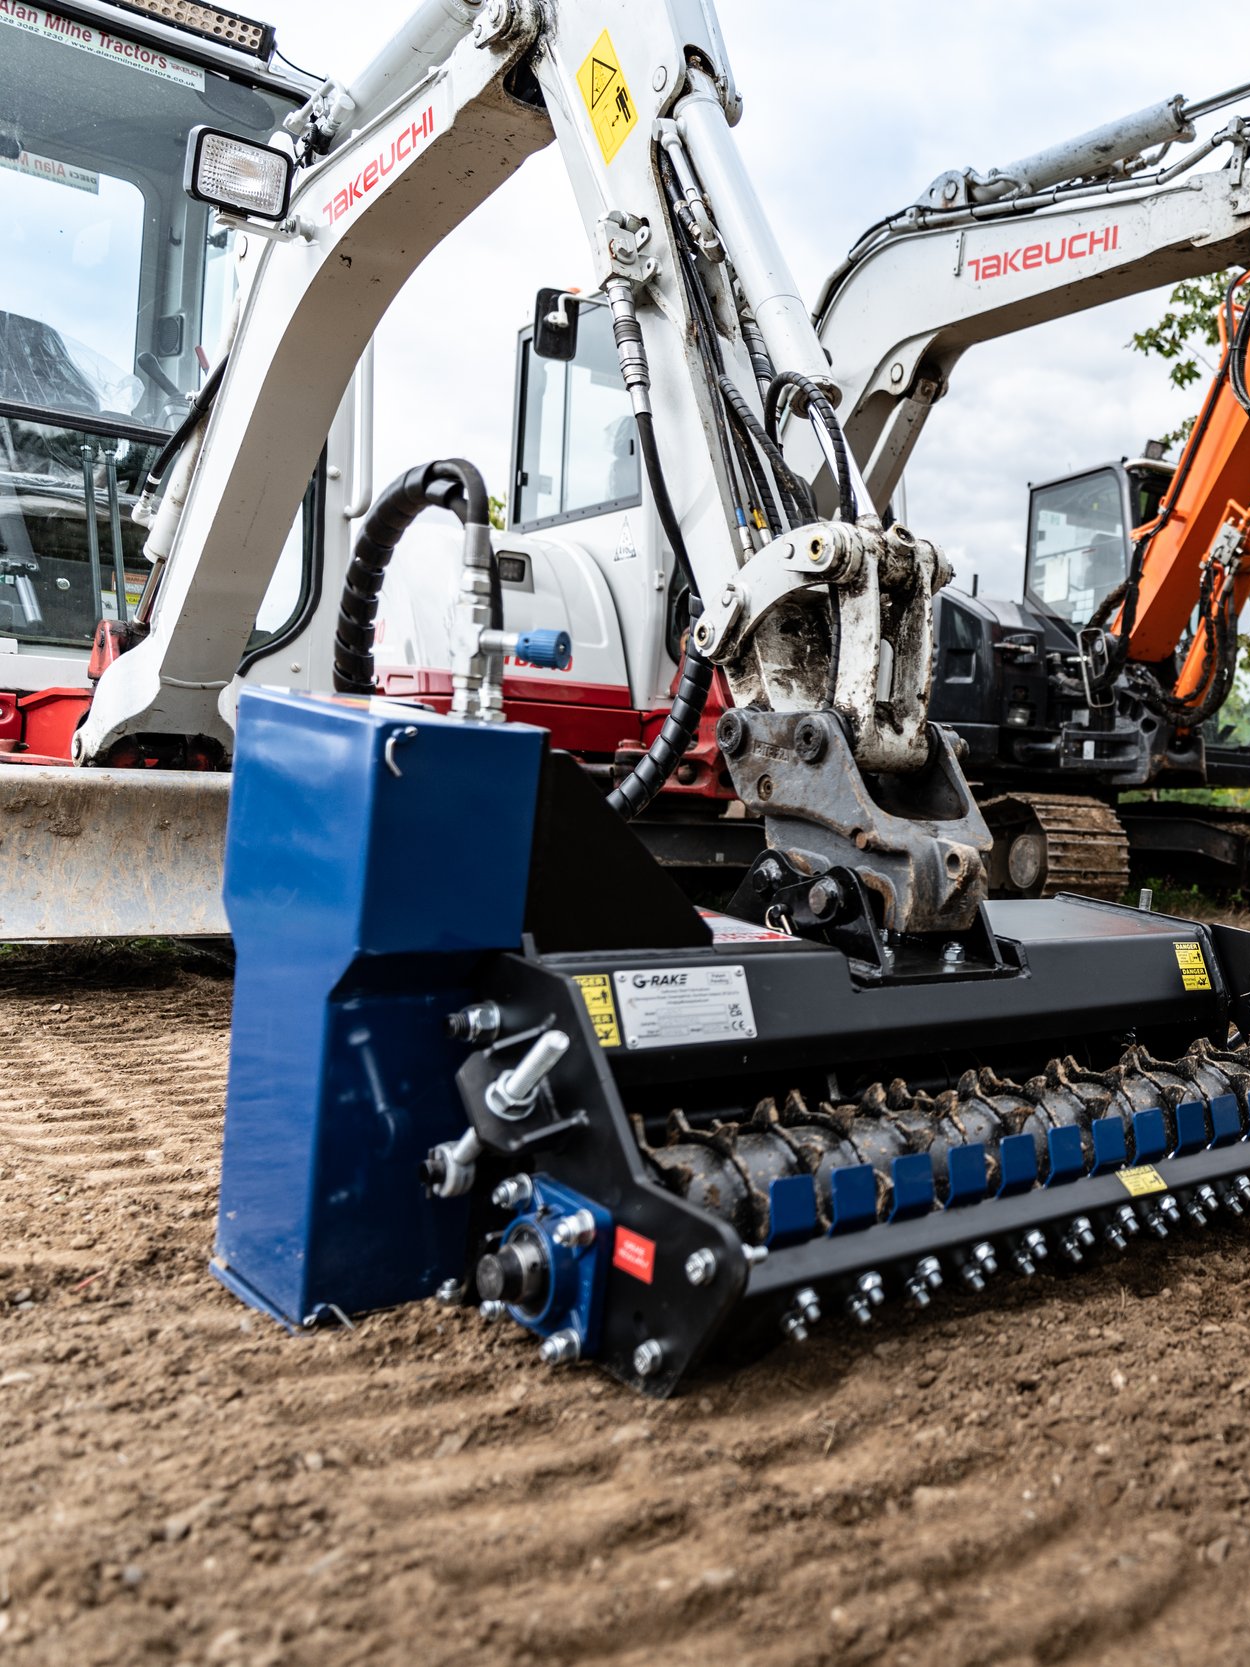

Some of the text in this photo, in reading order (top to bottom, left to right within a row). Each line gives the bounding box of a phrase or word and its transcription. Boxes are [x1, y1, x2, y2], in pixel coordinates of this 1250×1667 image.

[0, 0, 38, 24] Alan
[44, 14, 92, 43] Milne
[98, 31, 168, 70] Tractors
[43, 30, 64, 42] 1230
[71, 40, 197, 88] www.alanmilnetractors.co.uk
[322, 105, 434, 226] TAKEUCHI
[967, 224, 1119, 282] TAKEUCHI
[632, 974, 688, 989] G-RAKE
